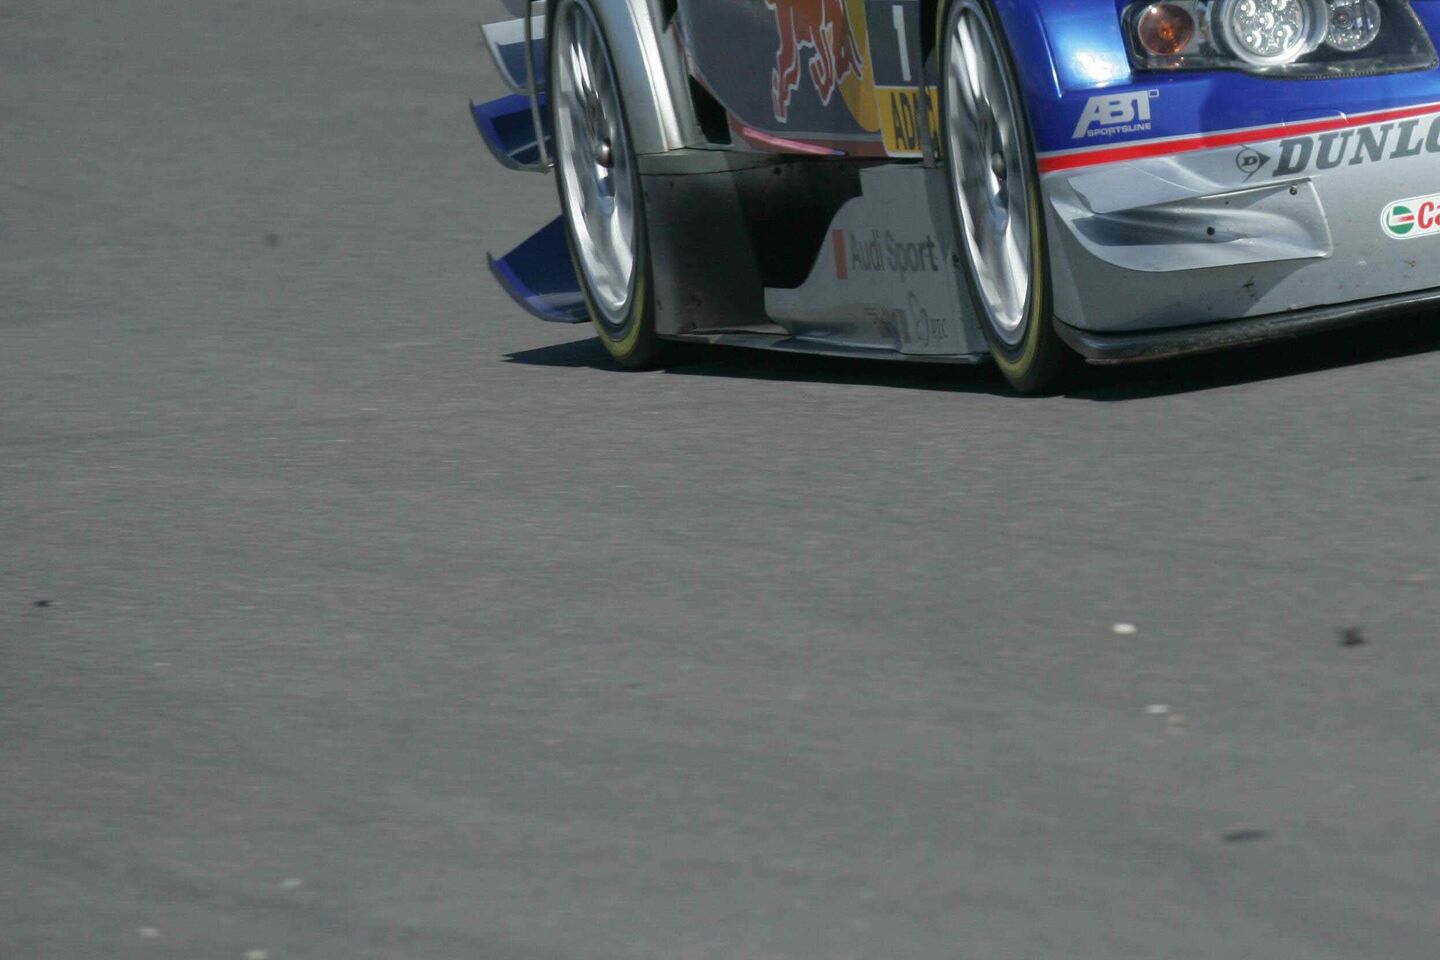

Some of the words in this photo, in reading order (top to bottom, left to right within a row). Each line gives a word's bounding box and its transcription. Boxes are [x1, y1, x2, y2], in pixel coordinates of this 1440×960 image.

[892, 5, 912, 81] 1
[1072, 90, 1151, 139] ABT
[1087, 123, 1152, 137] SPORTSLINE
[851, 227, 885, 272] Audi
[885, 229, 939, 283] Sport
